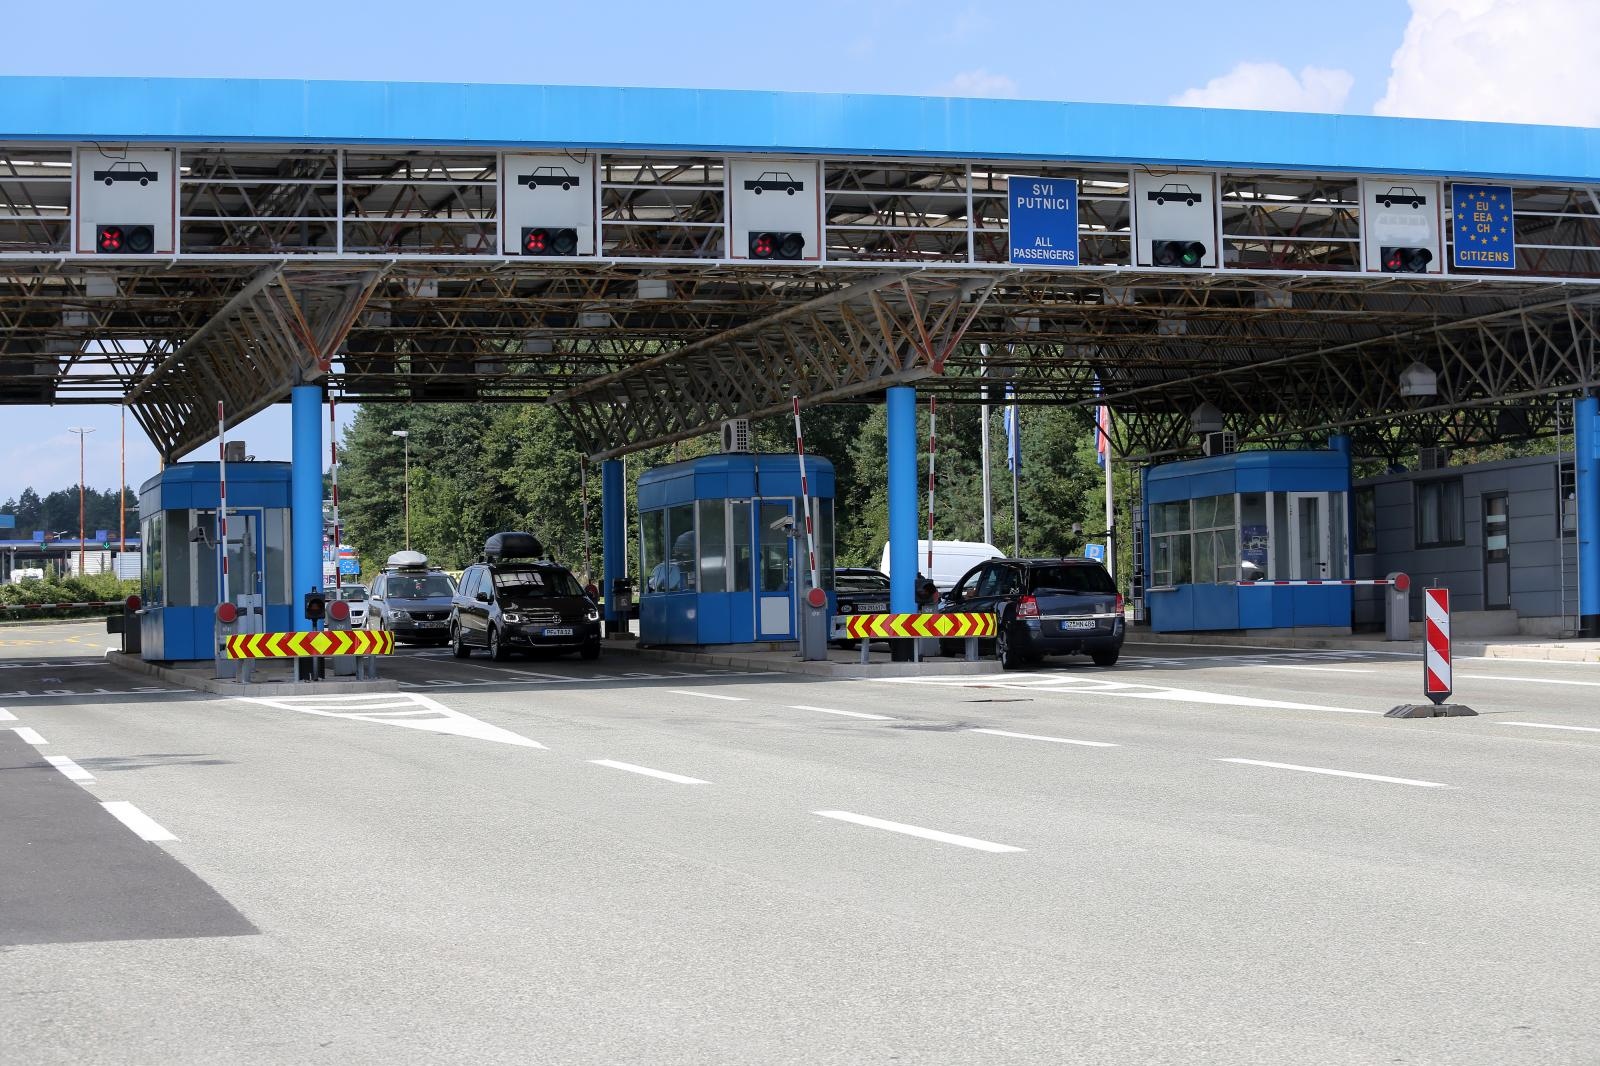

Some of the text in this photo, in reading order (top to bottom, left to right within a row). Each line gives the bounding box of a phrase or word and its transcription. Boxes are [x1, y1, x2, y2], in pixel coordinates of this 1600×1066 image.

[1033, 184, 1053, 196] SVI
[1017, 197, 1069, 210] PUTNICI
[1476, 202, 1489, 211] EU
[1473, 212, 1492, 222] EEA
[1477, 224, 1490, 233] CH
[1035, 236, 1052, 247] ALL
[1013, 248, 1075, 261] PASSENGERS
[1460, 251, 1509, 262] CITIZENS
